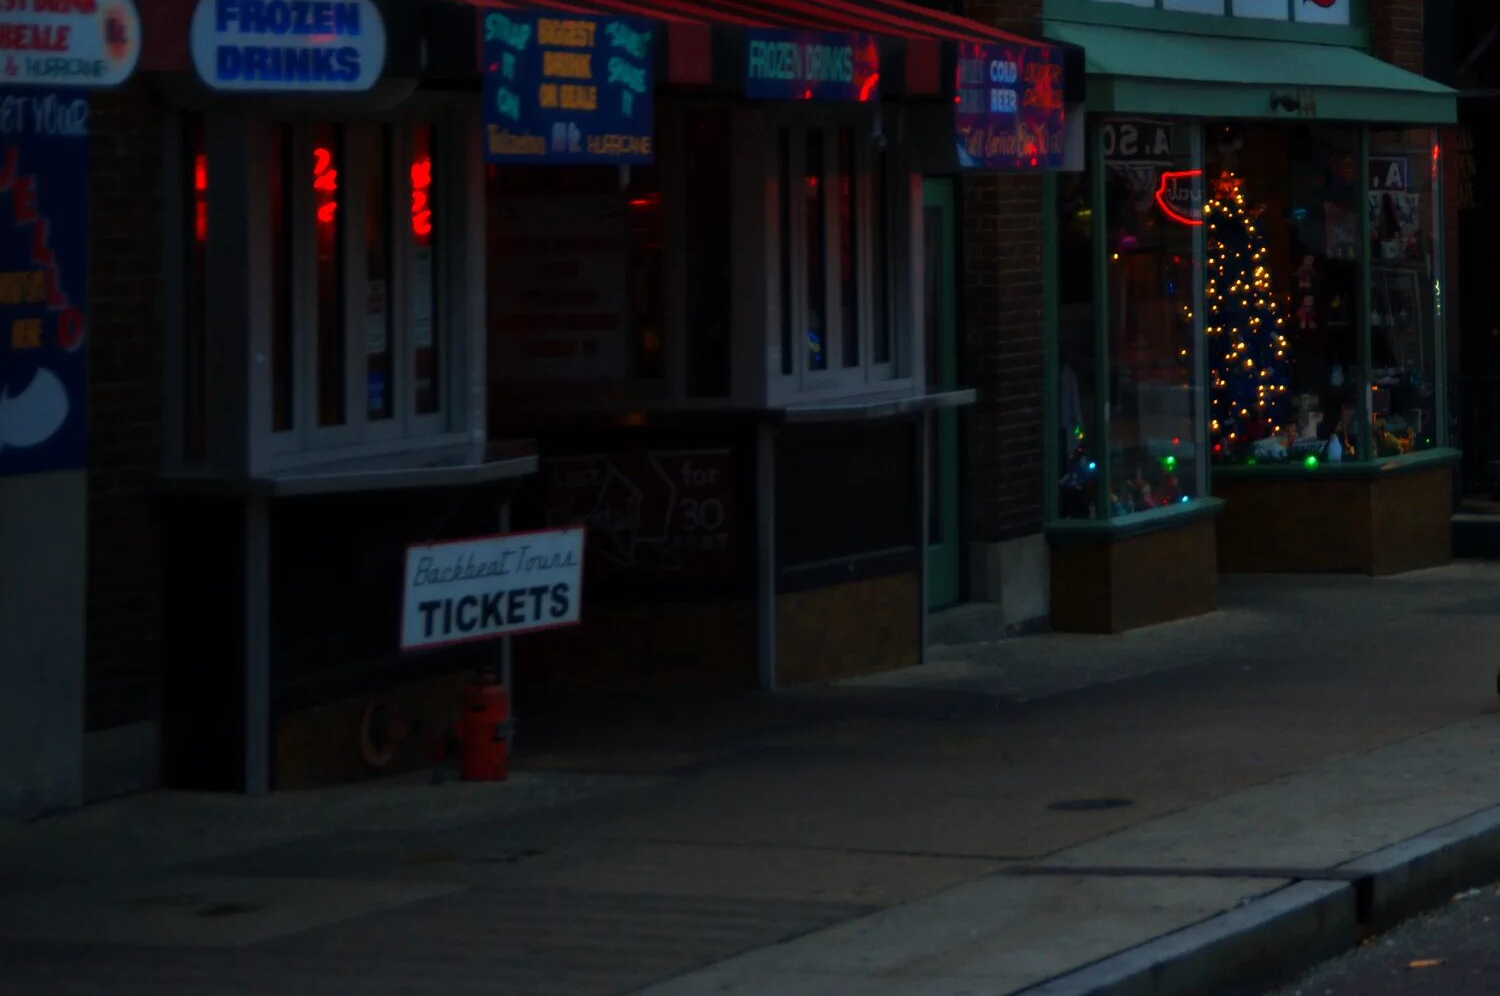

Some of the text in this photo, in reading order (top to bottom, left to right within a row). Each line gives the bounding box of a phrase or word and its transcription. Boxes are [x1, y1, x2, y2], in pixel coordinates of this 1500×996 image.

[216, 45, 361, 82] DRINKS
[750, 39, 853, 83] FROZEN DRINKS
[990, 59, 1017, 83] COLD
[990, 88, 1017, 113] BEER
[680, 497, 725, 531] 30
[413, 544, 578, 587] Backbeat Tours
[419, 582, 570, 638] TICKETS
